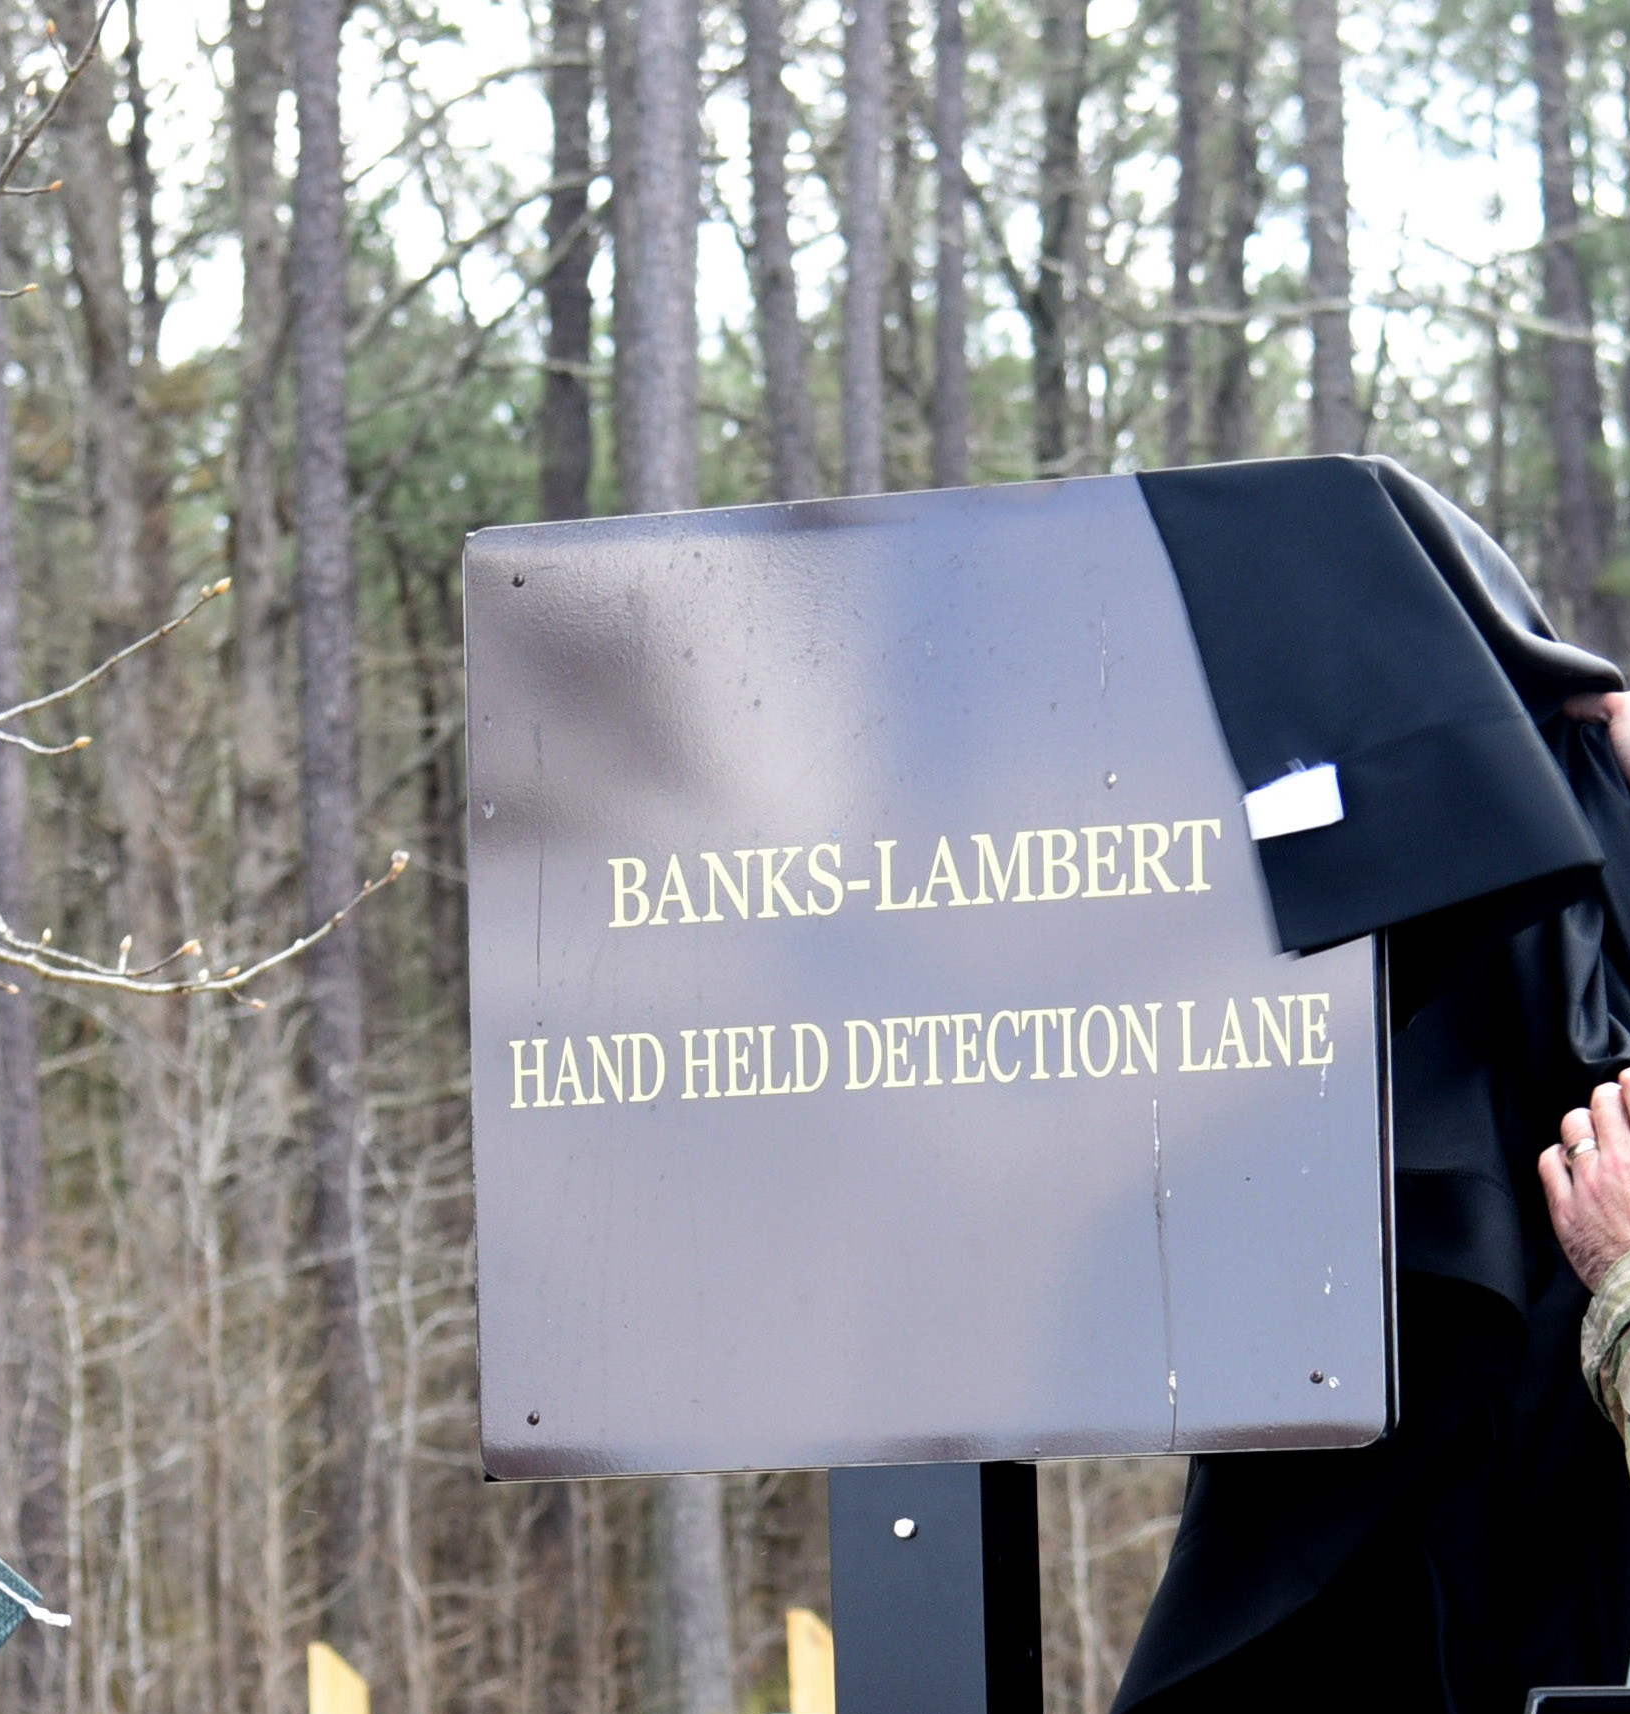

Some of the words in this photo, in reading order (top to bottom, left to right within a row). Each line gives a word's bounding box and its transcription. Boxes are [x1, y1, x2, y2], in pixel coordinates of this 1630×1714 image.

[608, 819, 1221, 928] BANKS-LAMBERT
[509, 1031, 666, 1109] HAND
[680, 1022, 829, 1100] HELD
[845, 1002, 1164, 1091] DETECTION
[1178, 992, 1335, 1074] LANE
